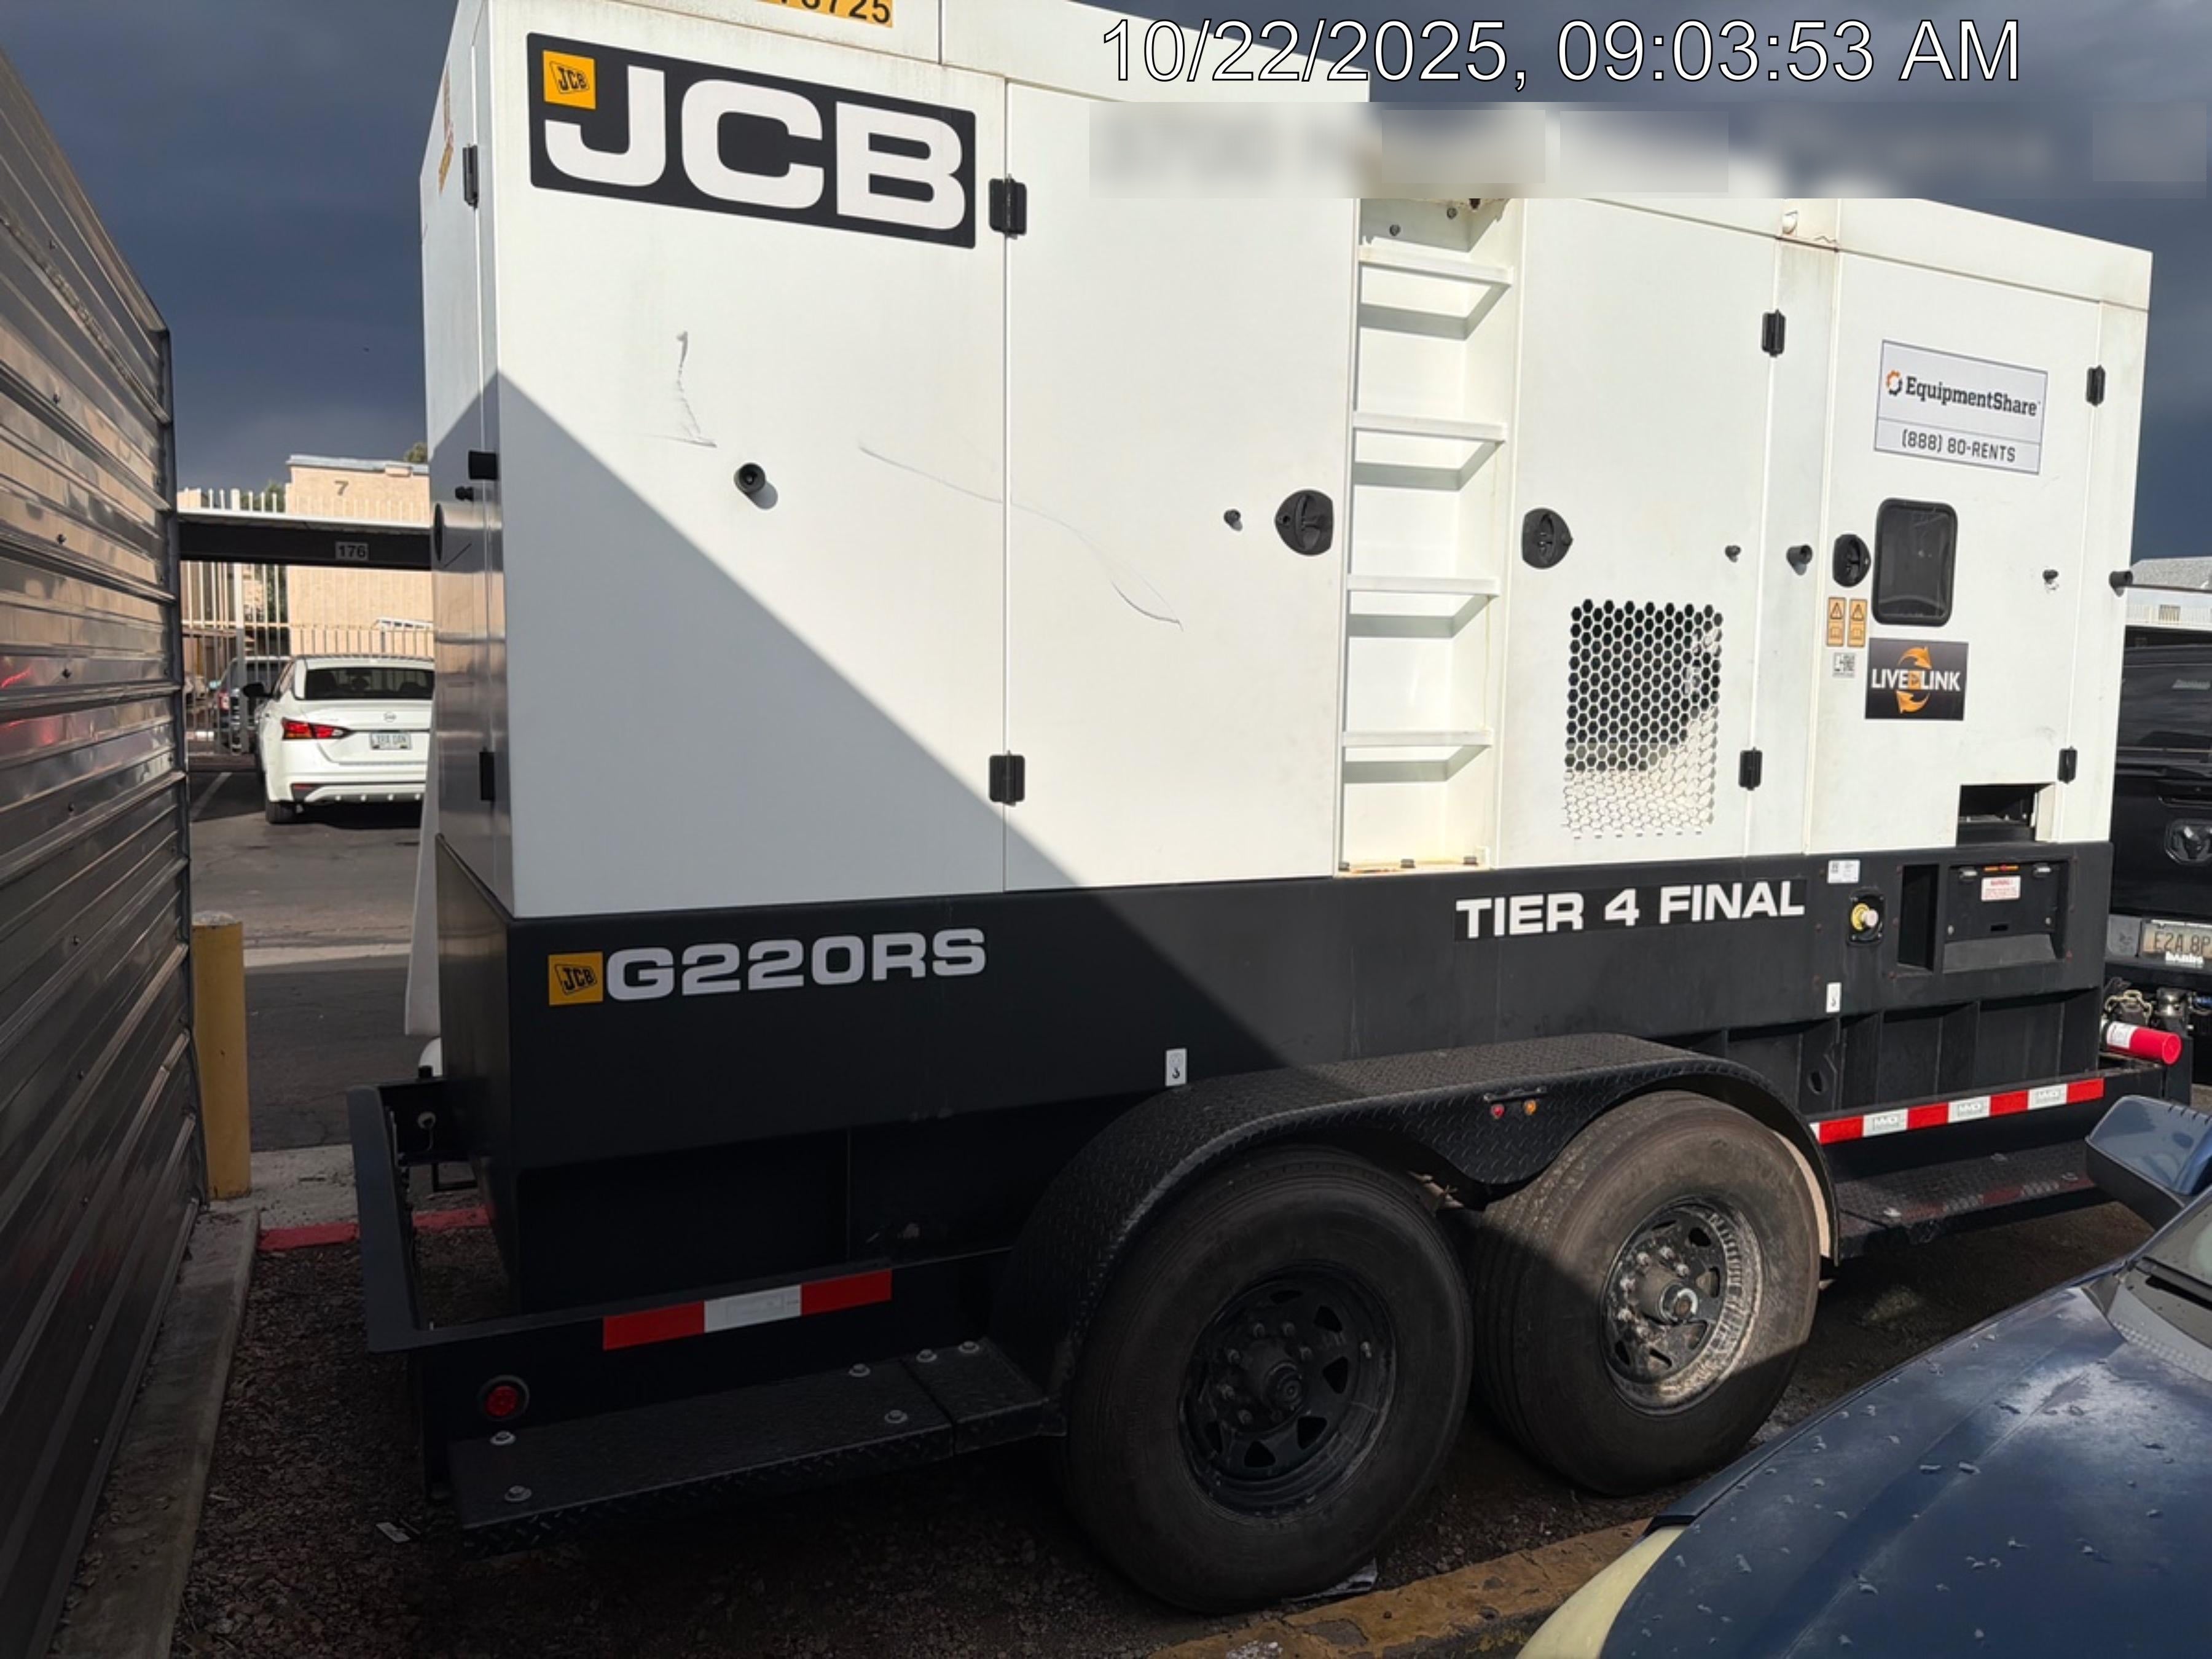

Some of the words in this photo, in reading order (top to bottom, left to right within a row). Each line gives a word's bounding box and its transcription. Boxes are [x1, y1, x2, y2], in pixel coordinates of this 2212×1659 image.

[557, 66, 587, 91] JCB
[544, 65, 965, 230] JCB
[1906, 376, 2037, 417] EquipmentShare
[1902, 428, 1943, 453] (888)
[1947, 437, 2016, 462] 80-RENTS
[334, 480, 349, 496] 7
[339, 545, 366, 558] 176
[1456, 892, 1583, 939] TIER
[1604, 888, 1640, 927] 4
[1660, 880, 1805, 924] FINAL
[563, 967, 594, 990] JCB
[606, 928, 986, 1001] G220RS
